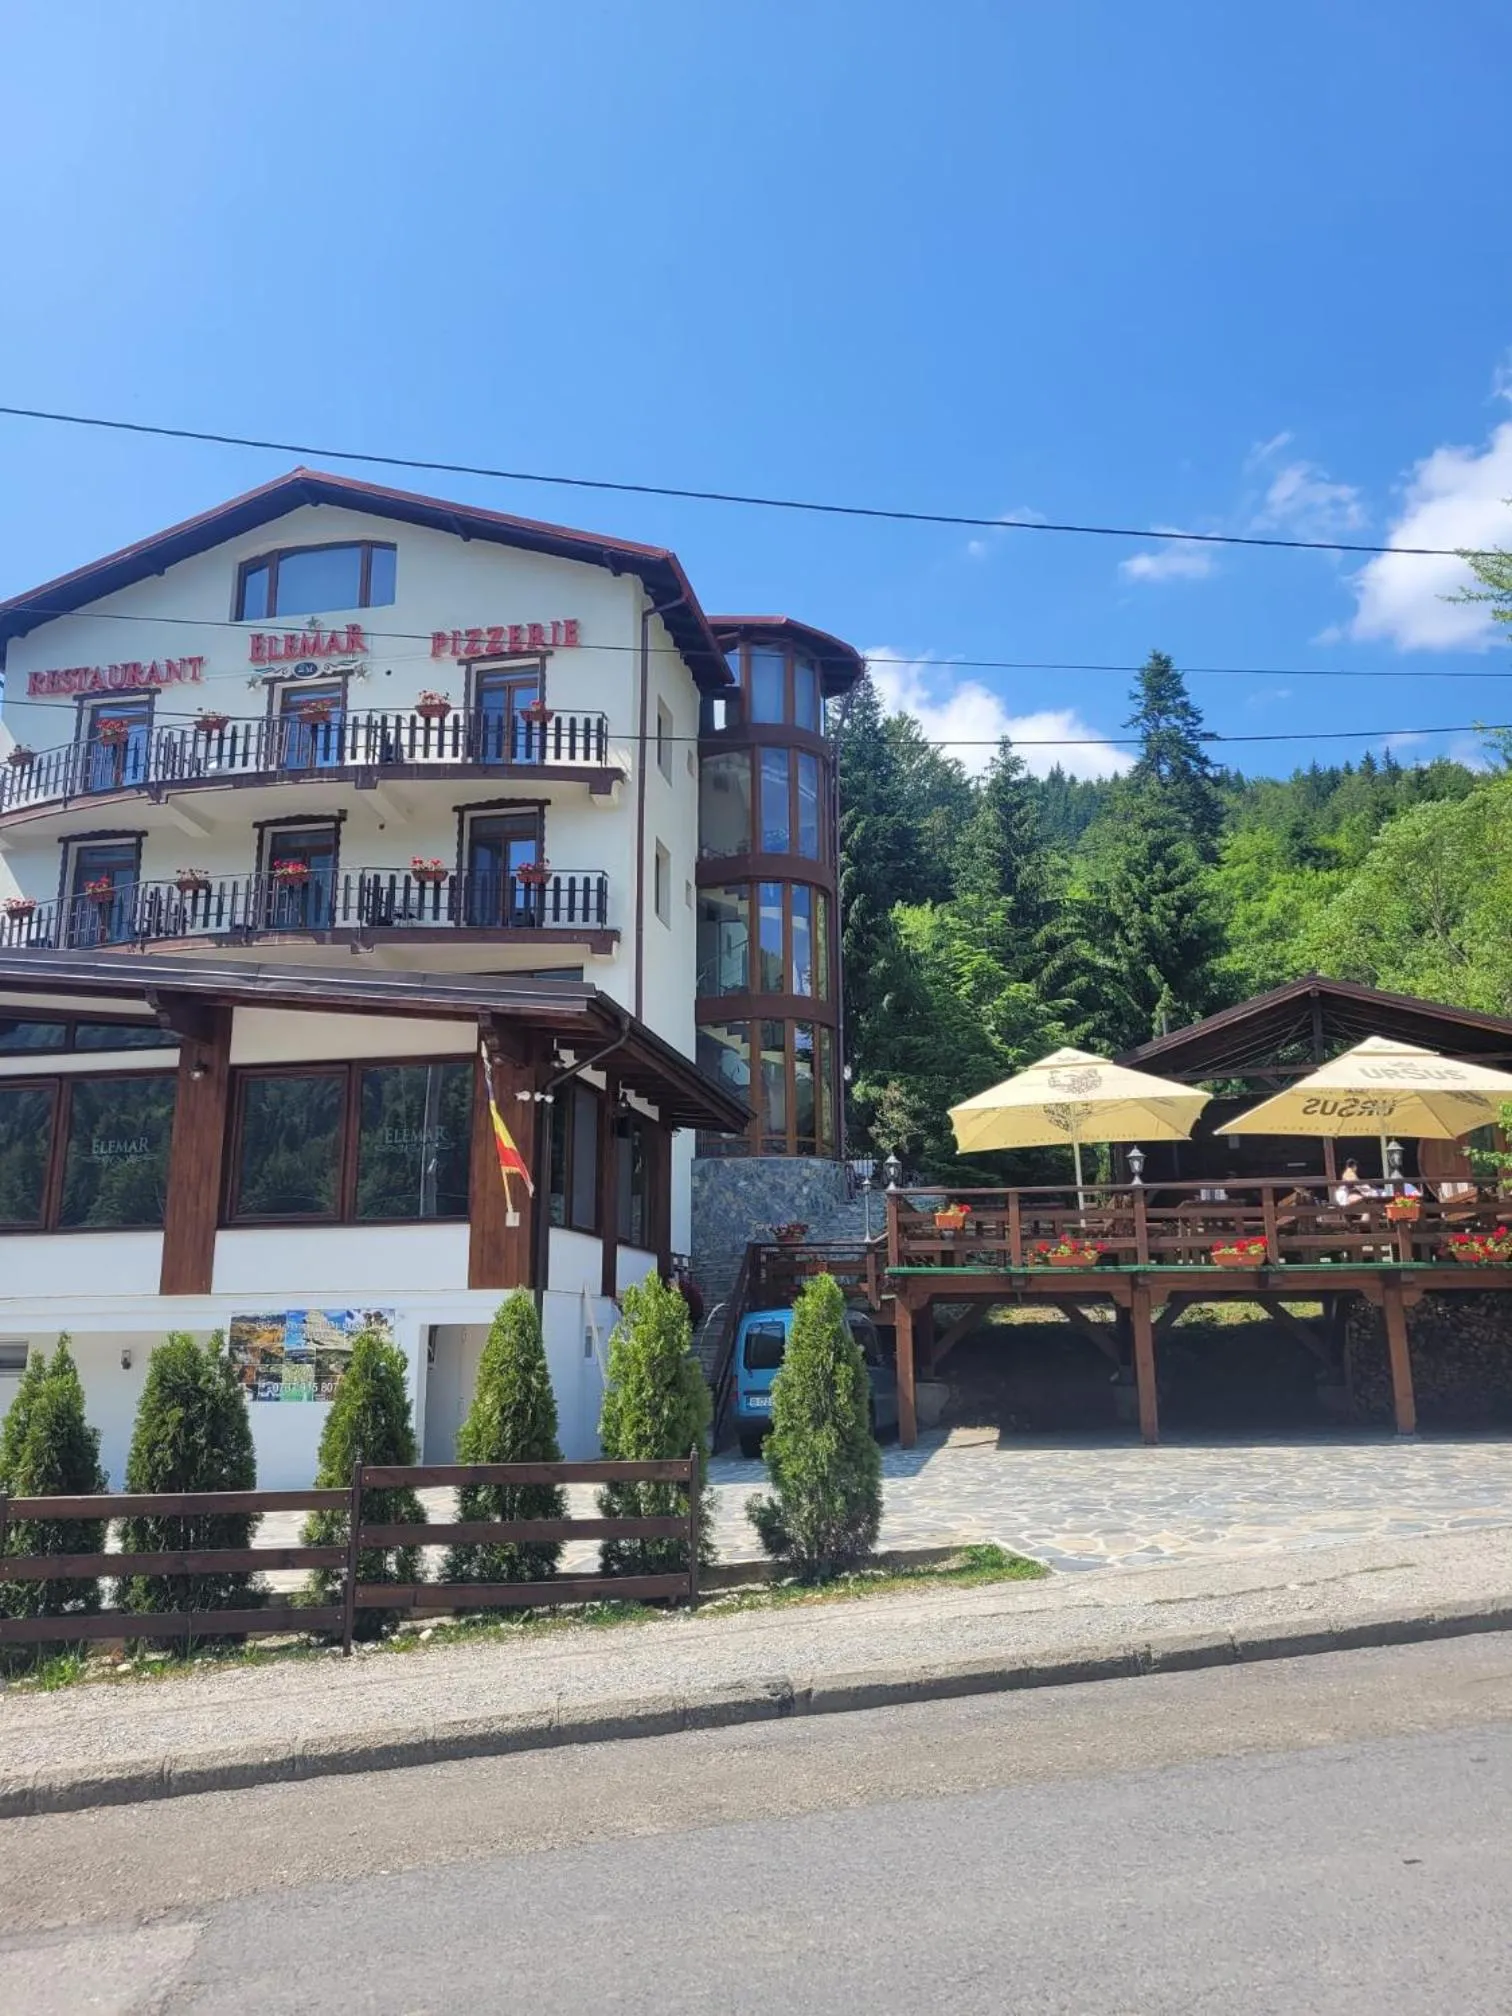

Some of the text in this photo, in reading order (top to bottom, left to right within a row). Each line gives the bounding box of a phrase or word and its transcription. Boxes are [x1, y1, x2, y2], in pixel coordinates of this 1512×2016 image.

[248, 622, 369, 663] ELEMAR
[430, 618, 579, 659] PIZZERIE
[27, 655, 206, 697] RESTAURANT
[1358, 1068, 1468, 1080] URSUS
[91, 1136, 150, 1154] ELEMAR
